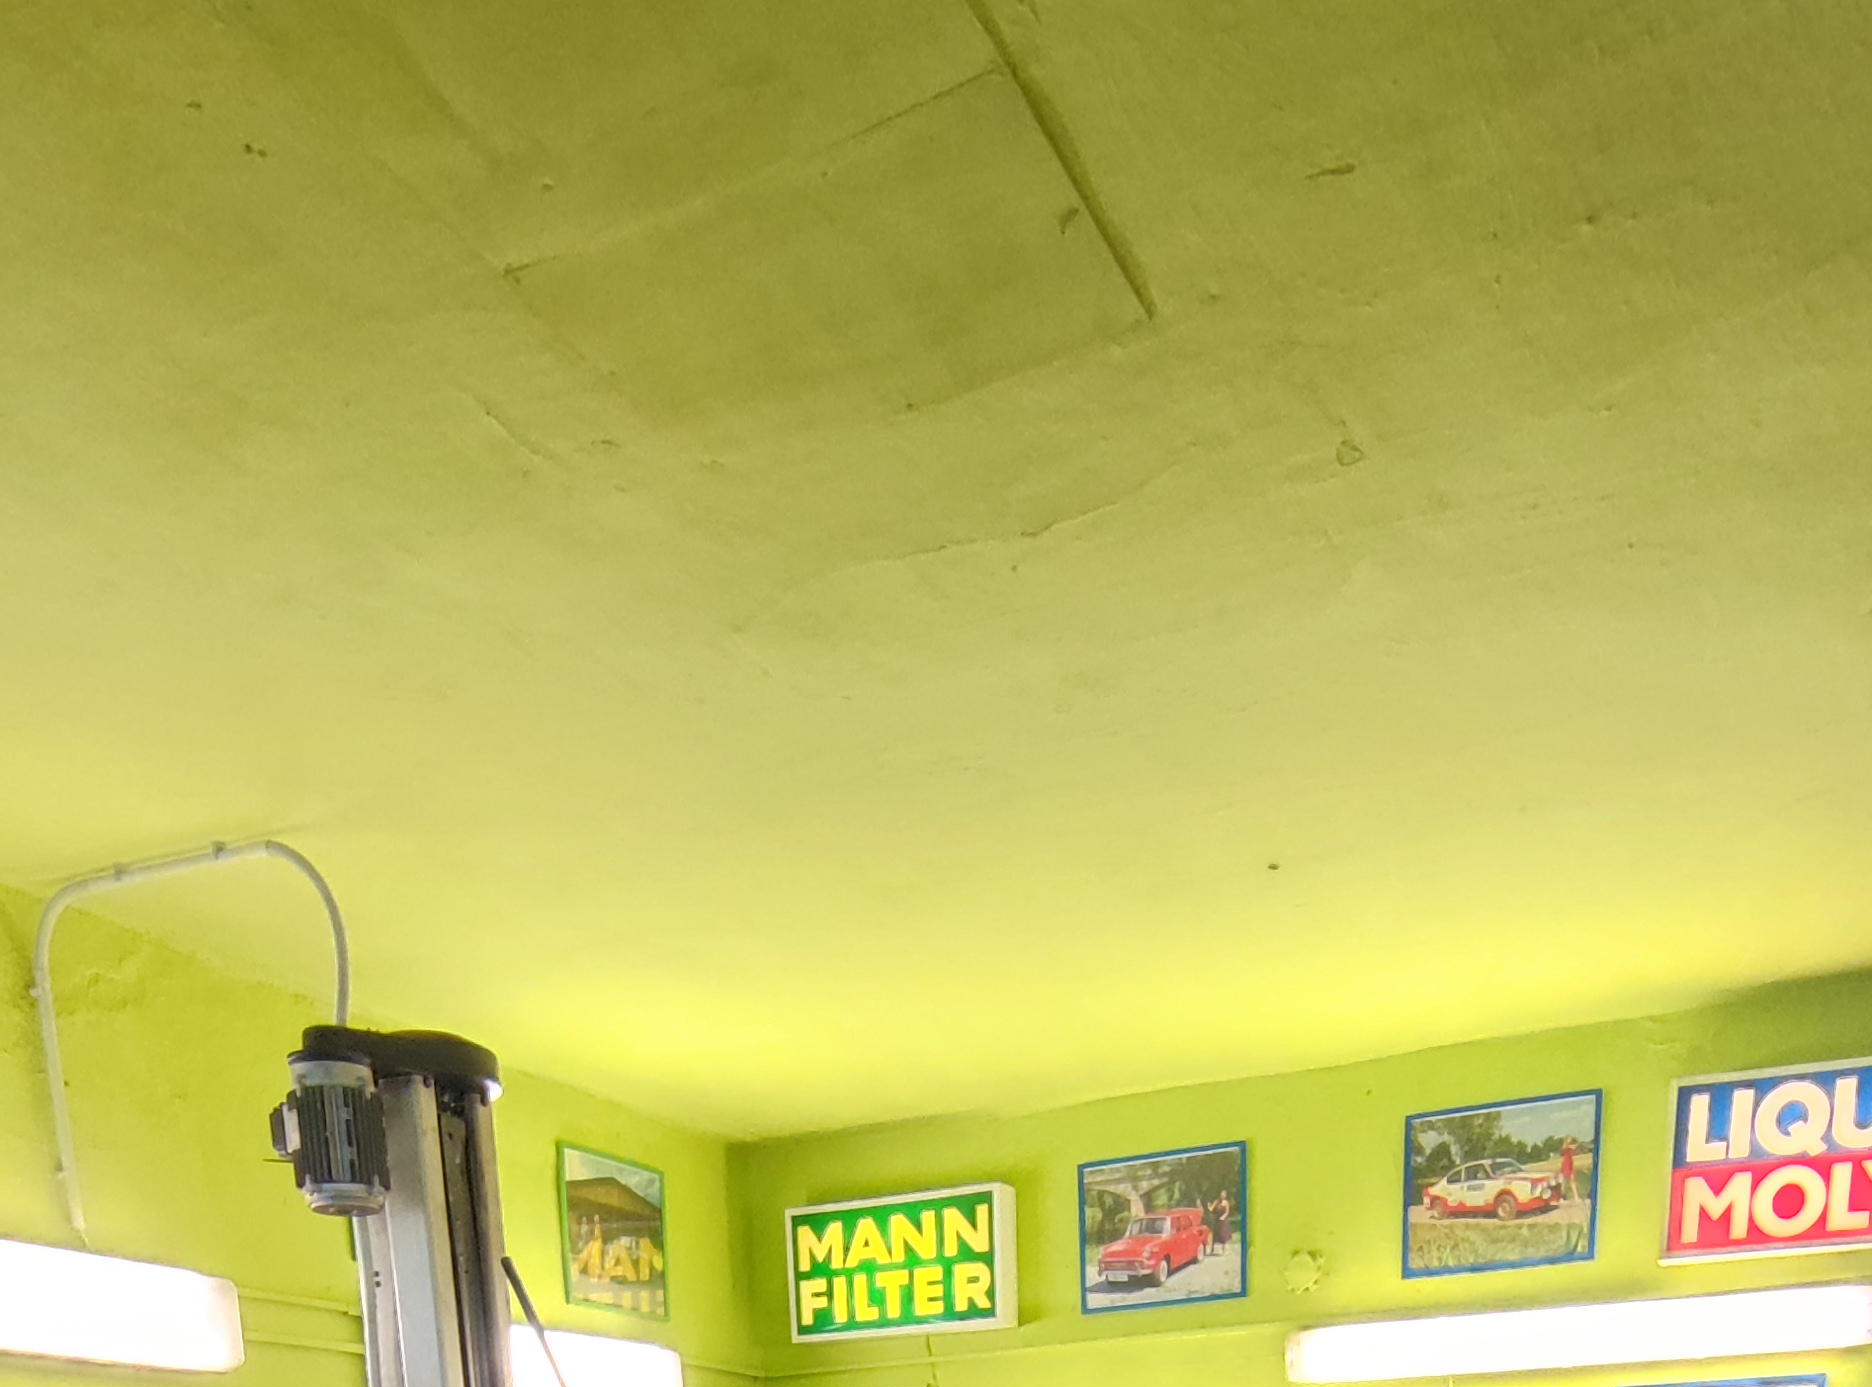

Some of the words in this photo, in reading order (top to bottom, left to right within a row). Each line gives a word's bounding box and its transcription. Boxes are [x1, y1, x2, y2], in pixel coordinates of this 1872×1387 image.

[1686, 1076, 1872, 1162] LIQU
[797, 1203, 989, 1272] MANN
[1681, 1160, 1872, 1243] MOL
[799, 1261, 992, 1326] FILTER
